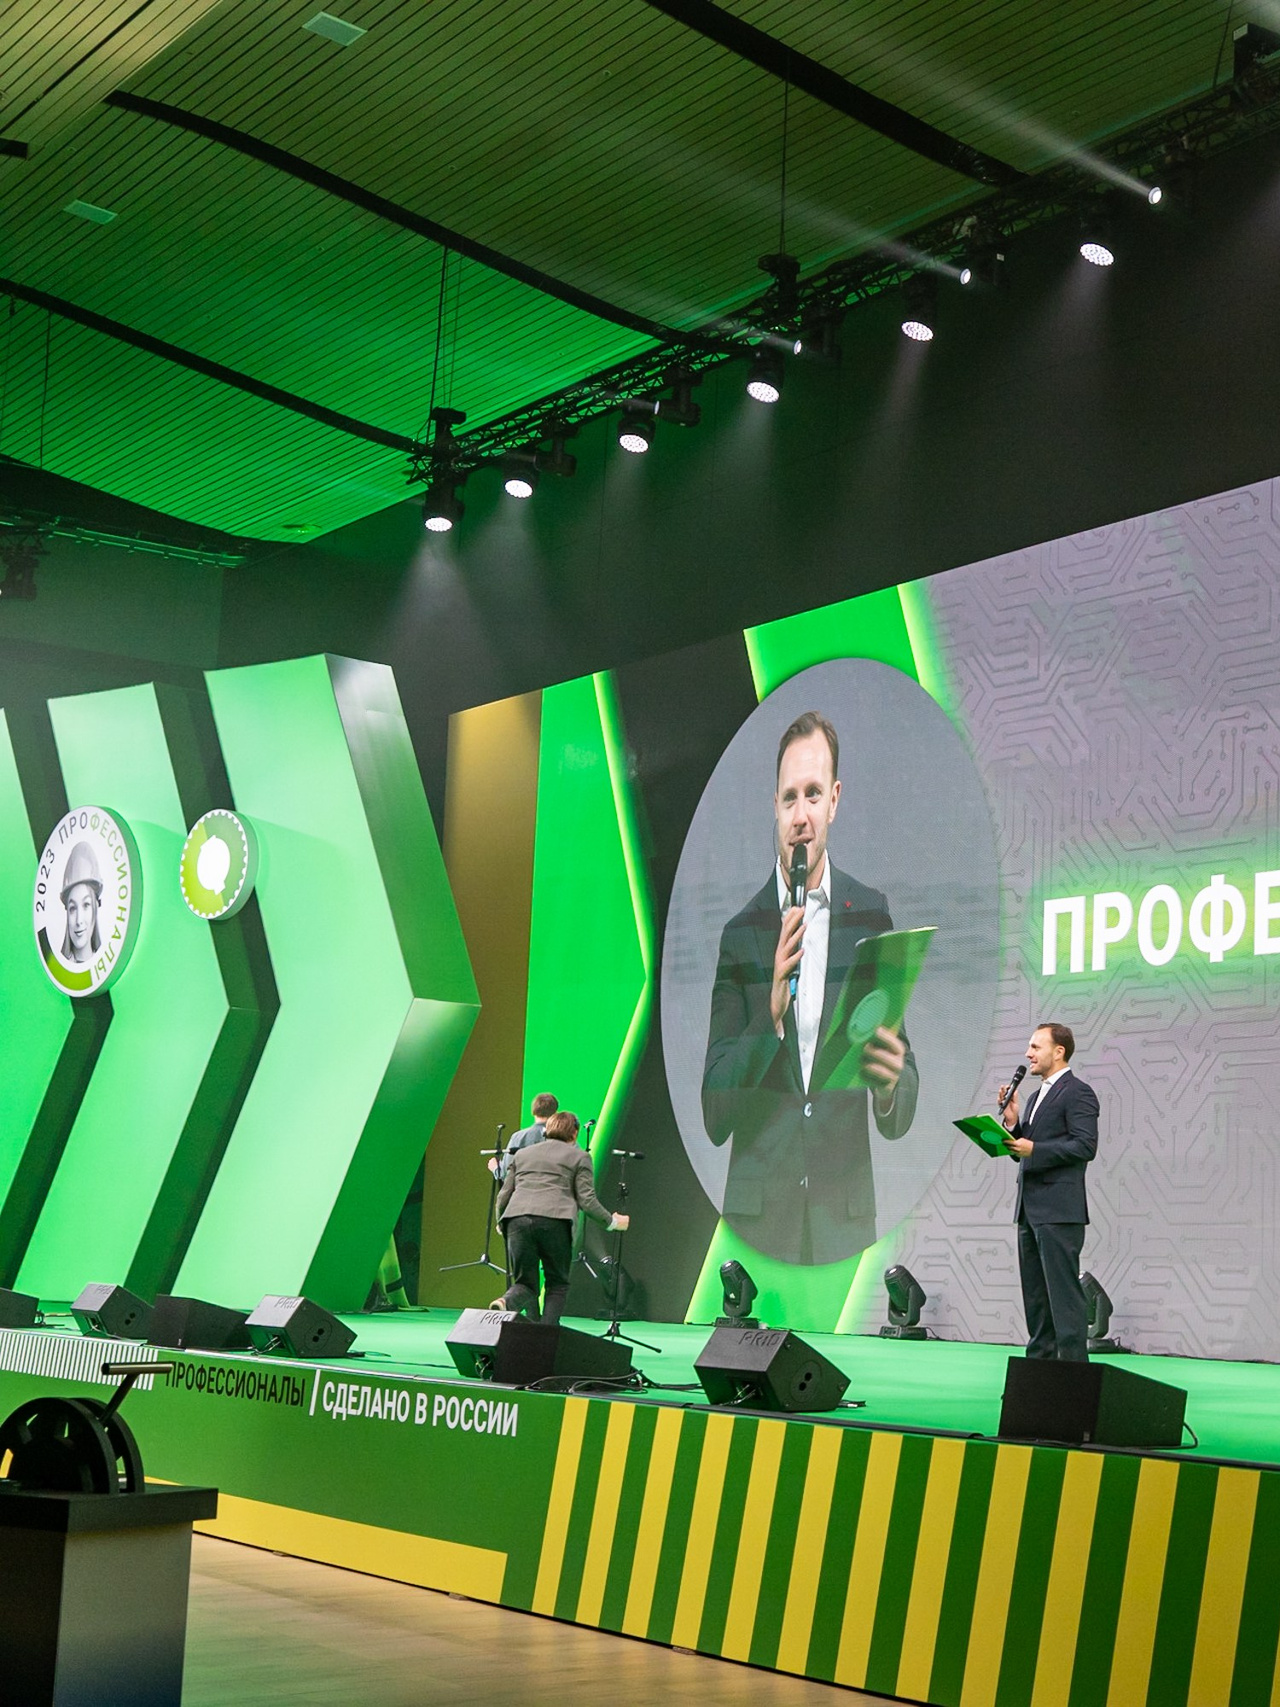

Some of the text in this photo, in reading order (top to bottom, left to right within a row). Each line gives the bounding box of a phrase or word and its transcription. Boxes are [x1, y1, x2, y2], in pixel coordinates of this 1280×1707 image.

[36, 811, 128, 981] 2023 ПРОФЕССИОНАЛЫ
[322, 1381, 410, 1421] СДЕЛАНО
[414, 1392, 428, 1425] В
[432, 1394, 519, 1437] РОССИИ
